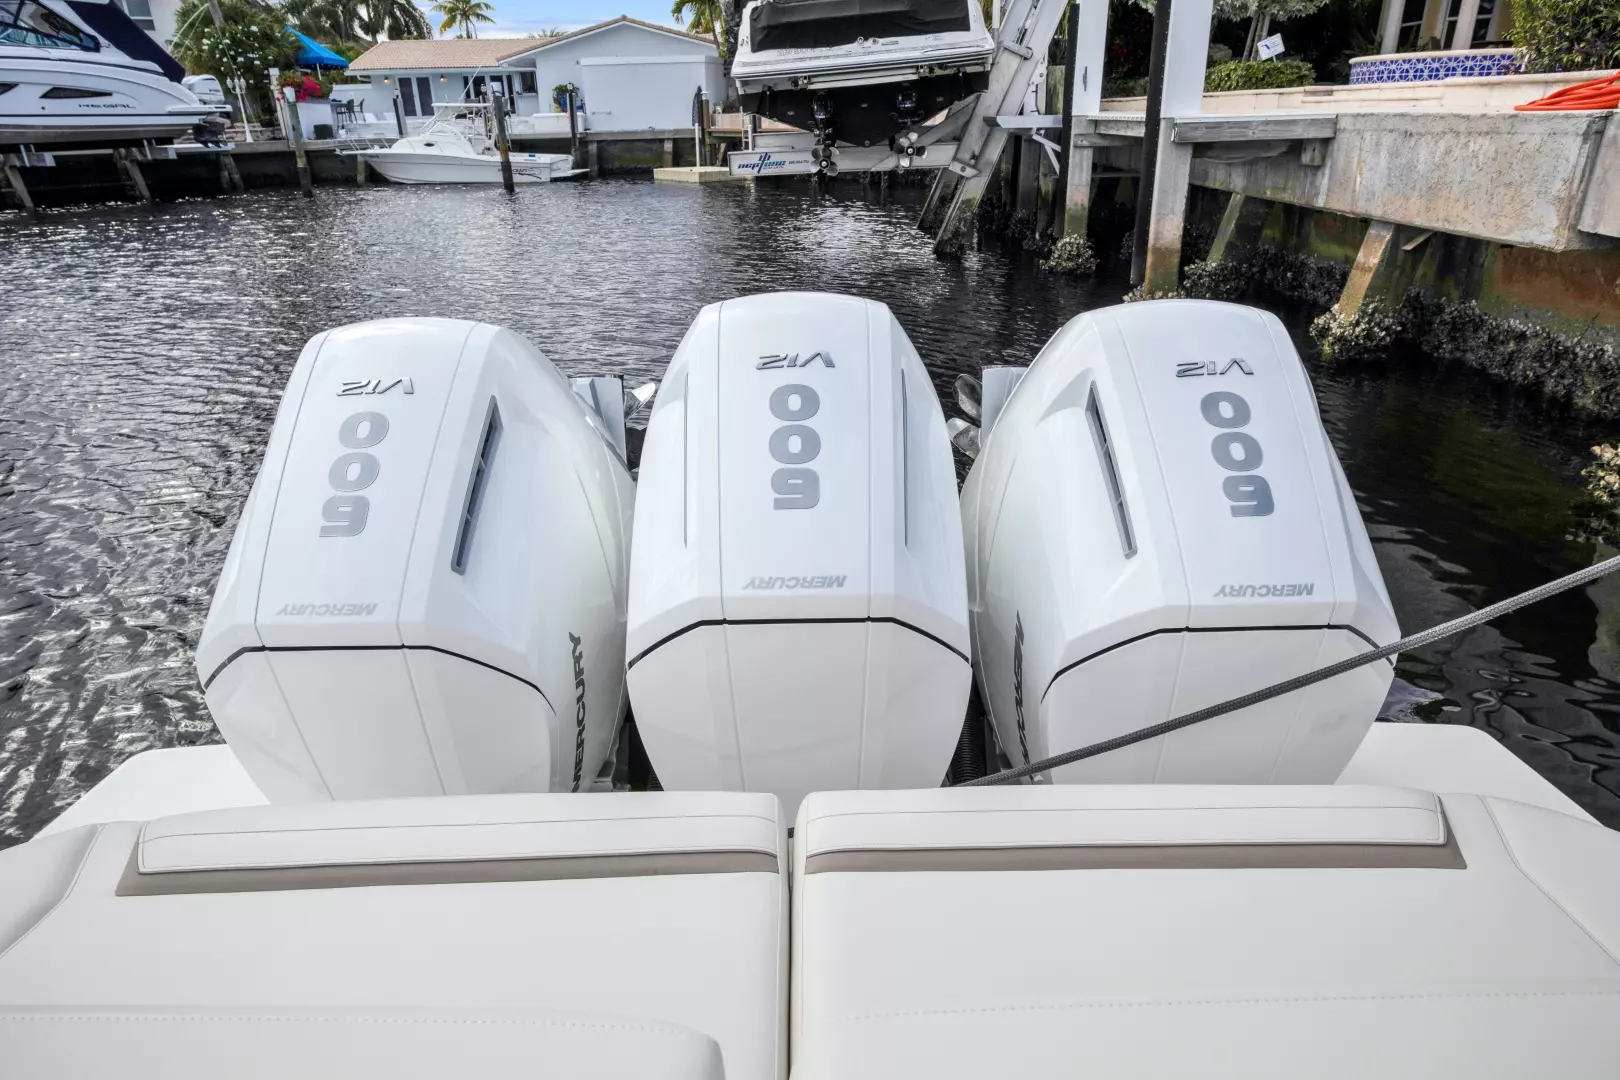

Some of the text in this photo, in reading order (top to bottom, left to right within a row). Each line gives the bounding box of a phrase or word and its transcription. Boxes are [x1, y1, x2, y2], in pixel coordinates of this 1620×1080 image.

[755, 350, 836, 370] V12
[1175, 357, 1255, 378] V12
[336, 376, 415, 397] V12
[768, 383, 822, 511] 600
[1199, 391, 1275, 518] 600
[318, 410, 390, 538] 600
[742, 575, 847, 590] MERCURY
[1213, 582, 1315, 598] MERCURY
[275, 602, 378, 617] MERCURY
